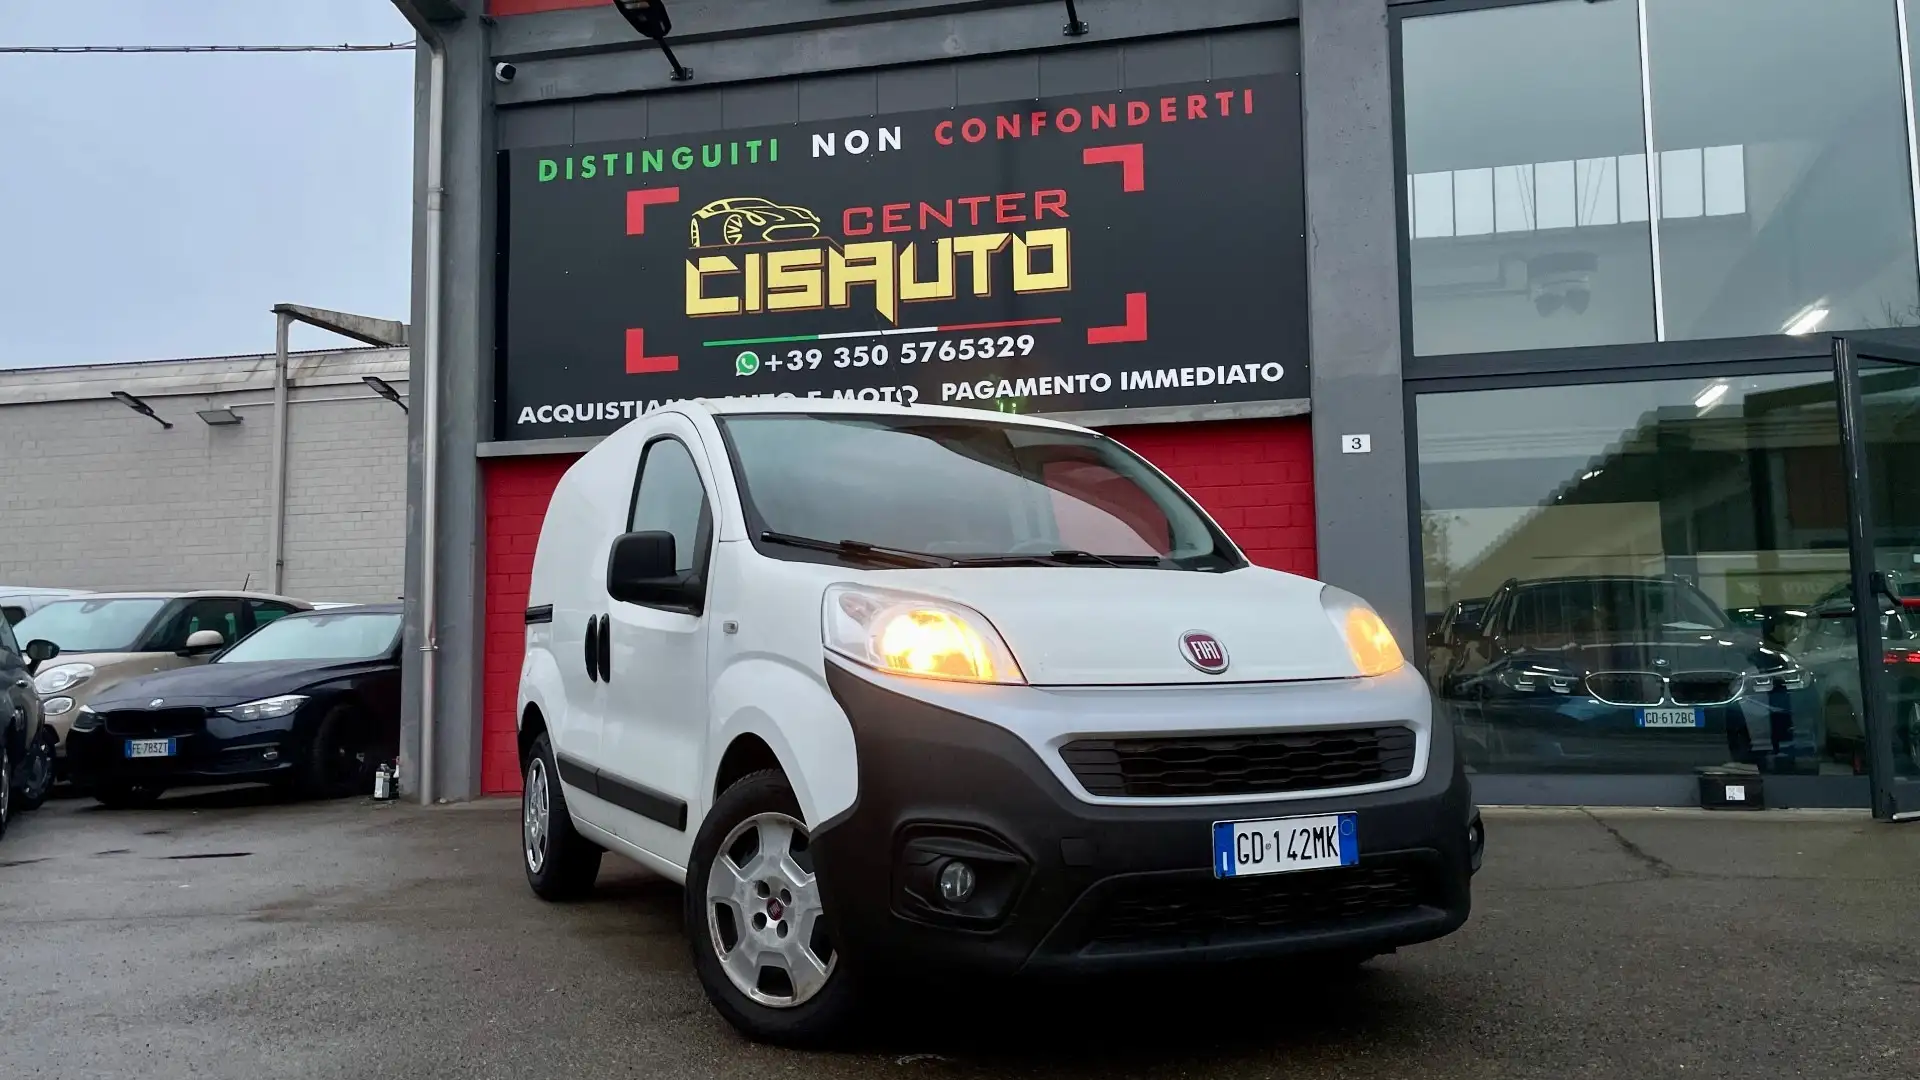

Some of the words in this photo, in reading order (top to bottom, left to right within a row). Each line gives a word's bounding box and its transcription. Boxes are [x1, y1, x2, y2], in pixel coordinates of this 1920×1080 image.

[538, 138, 779, 183] DISTINGUITI
[812, 126, 902, 158] NON
[934, 89, 1254, 146] CONFONDERTI
[842, 189, 1070, 236] CENTER
[685, 227, 1070, 326] CISAUTO
[764, 348, 822, 372] +39
[833, 342, 889, 368] 350
[899, 334, 1035, 365] 5765329
[940, 373, 1112, 403] PAGAMENTO
[1119, 361, 1285, 391] IMMEDIATO
[516, 397, 707, 424] ACQUISTIA
[1351, 437, 1362, 450] 3
[1190, 640, 1221, 660] FIAT
